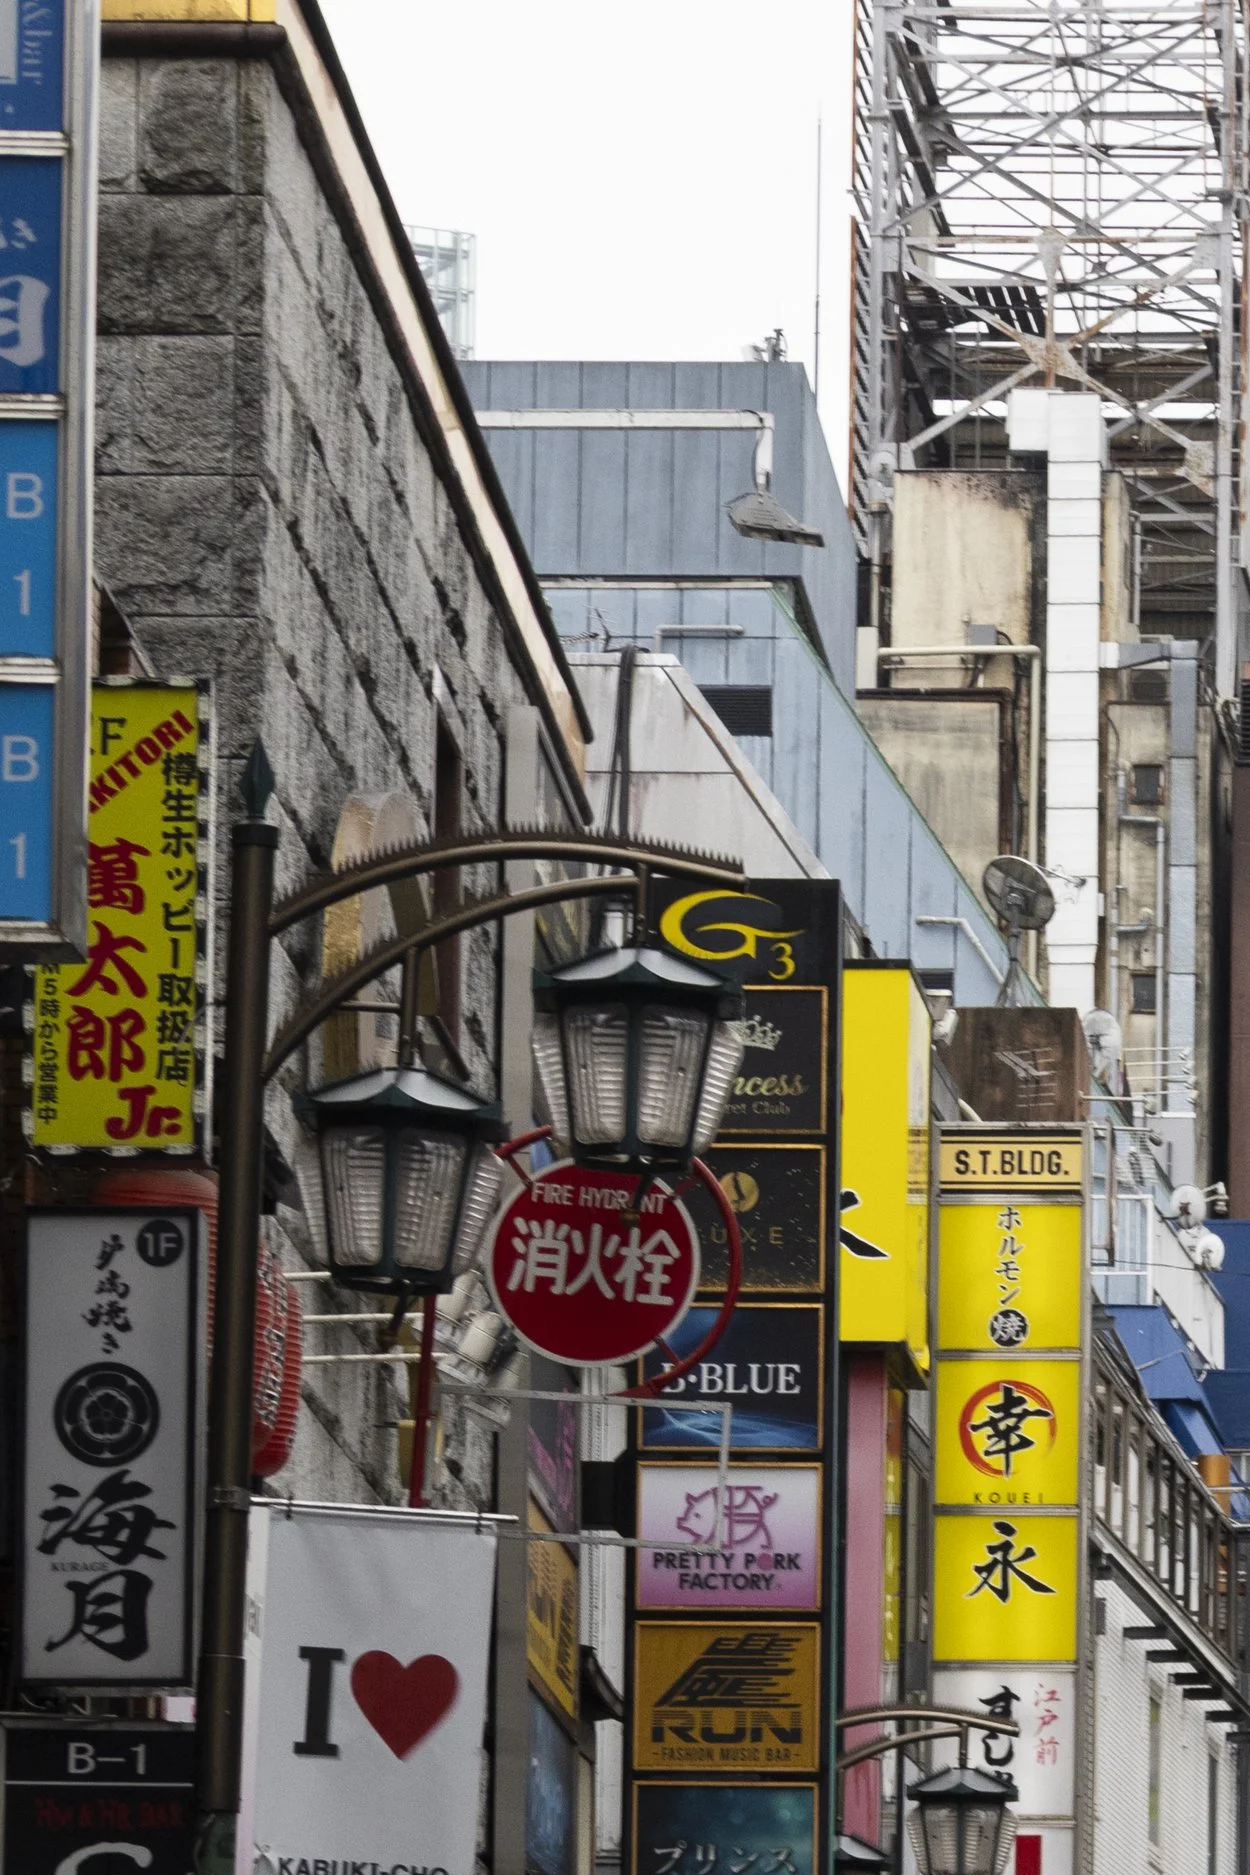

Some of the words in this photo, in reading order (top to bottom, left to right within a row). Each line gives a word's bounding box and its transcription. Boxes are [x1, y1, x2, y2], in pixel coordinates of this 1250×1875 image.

[955, 1149, 1070, 1176] S.T.BLDG.
[532, 1181, 574, 1207] FIRE
[578, 1187, 668, 1215] HYDRNT
[144, 1232, 178, 1258] 1F
[507, 1217, 681, 1305] 消火栓
[969, 1384, 1052, 1479] 幸
[36, 1470, 177, 1661] 海月
[50, 1560, 110, 1573] KURAGE
[653, 1552, 733, 1571] PRETTY
[964, 1521, 1057, 1602] 永
[679, 1571, 775, 1591] FACTORY
[293, 1645, 346, 1759] I
[651, 1710, 801, 1745] RUN
[68, 1743, 149, 1775] B-1
[719, 1748, 760, 1763] MUSIC
[654, 1845, 798, 1875] プリンス
